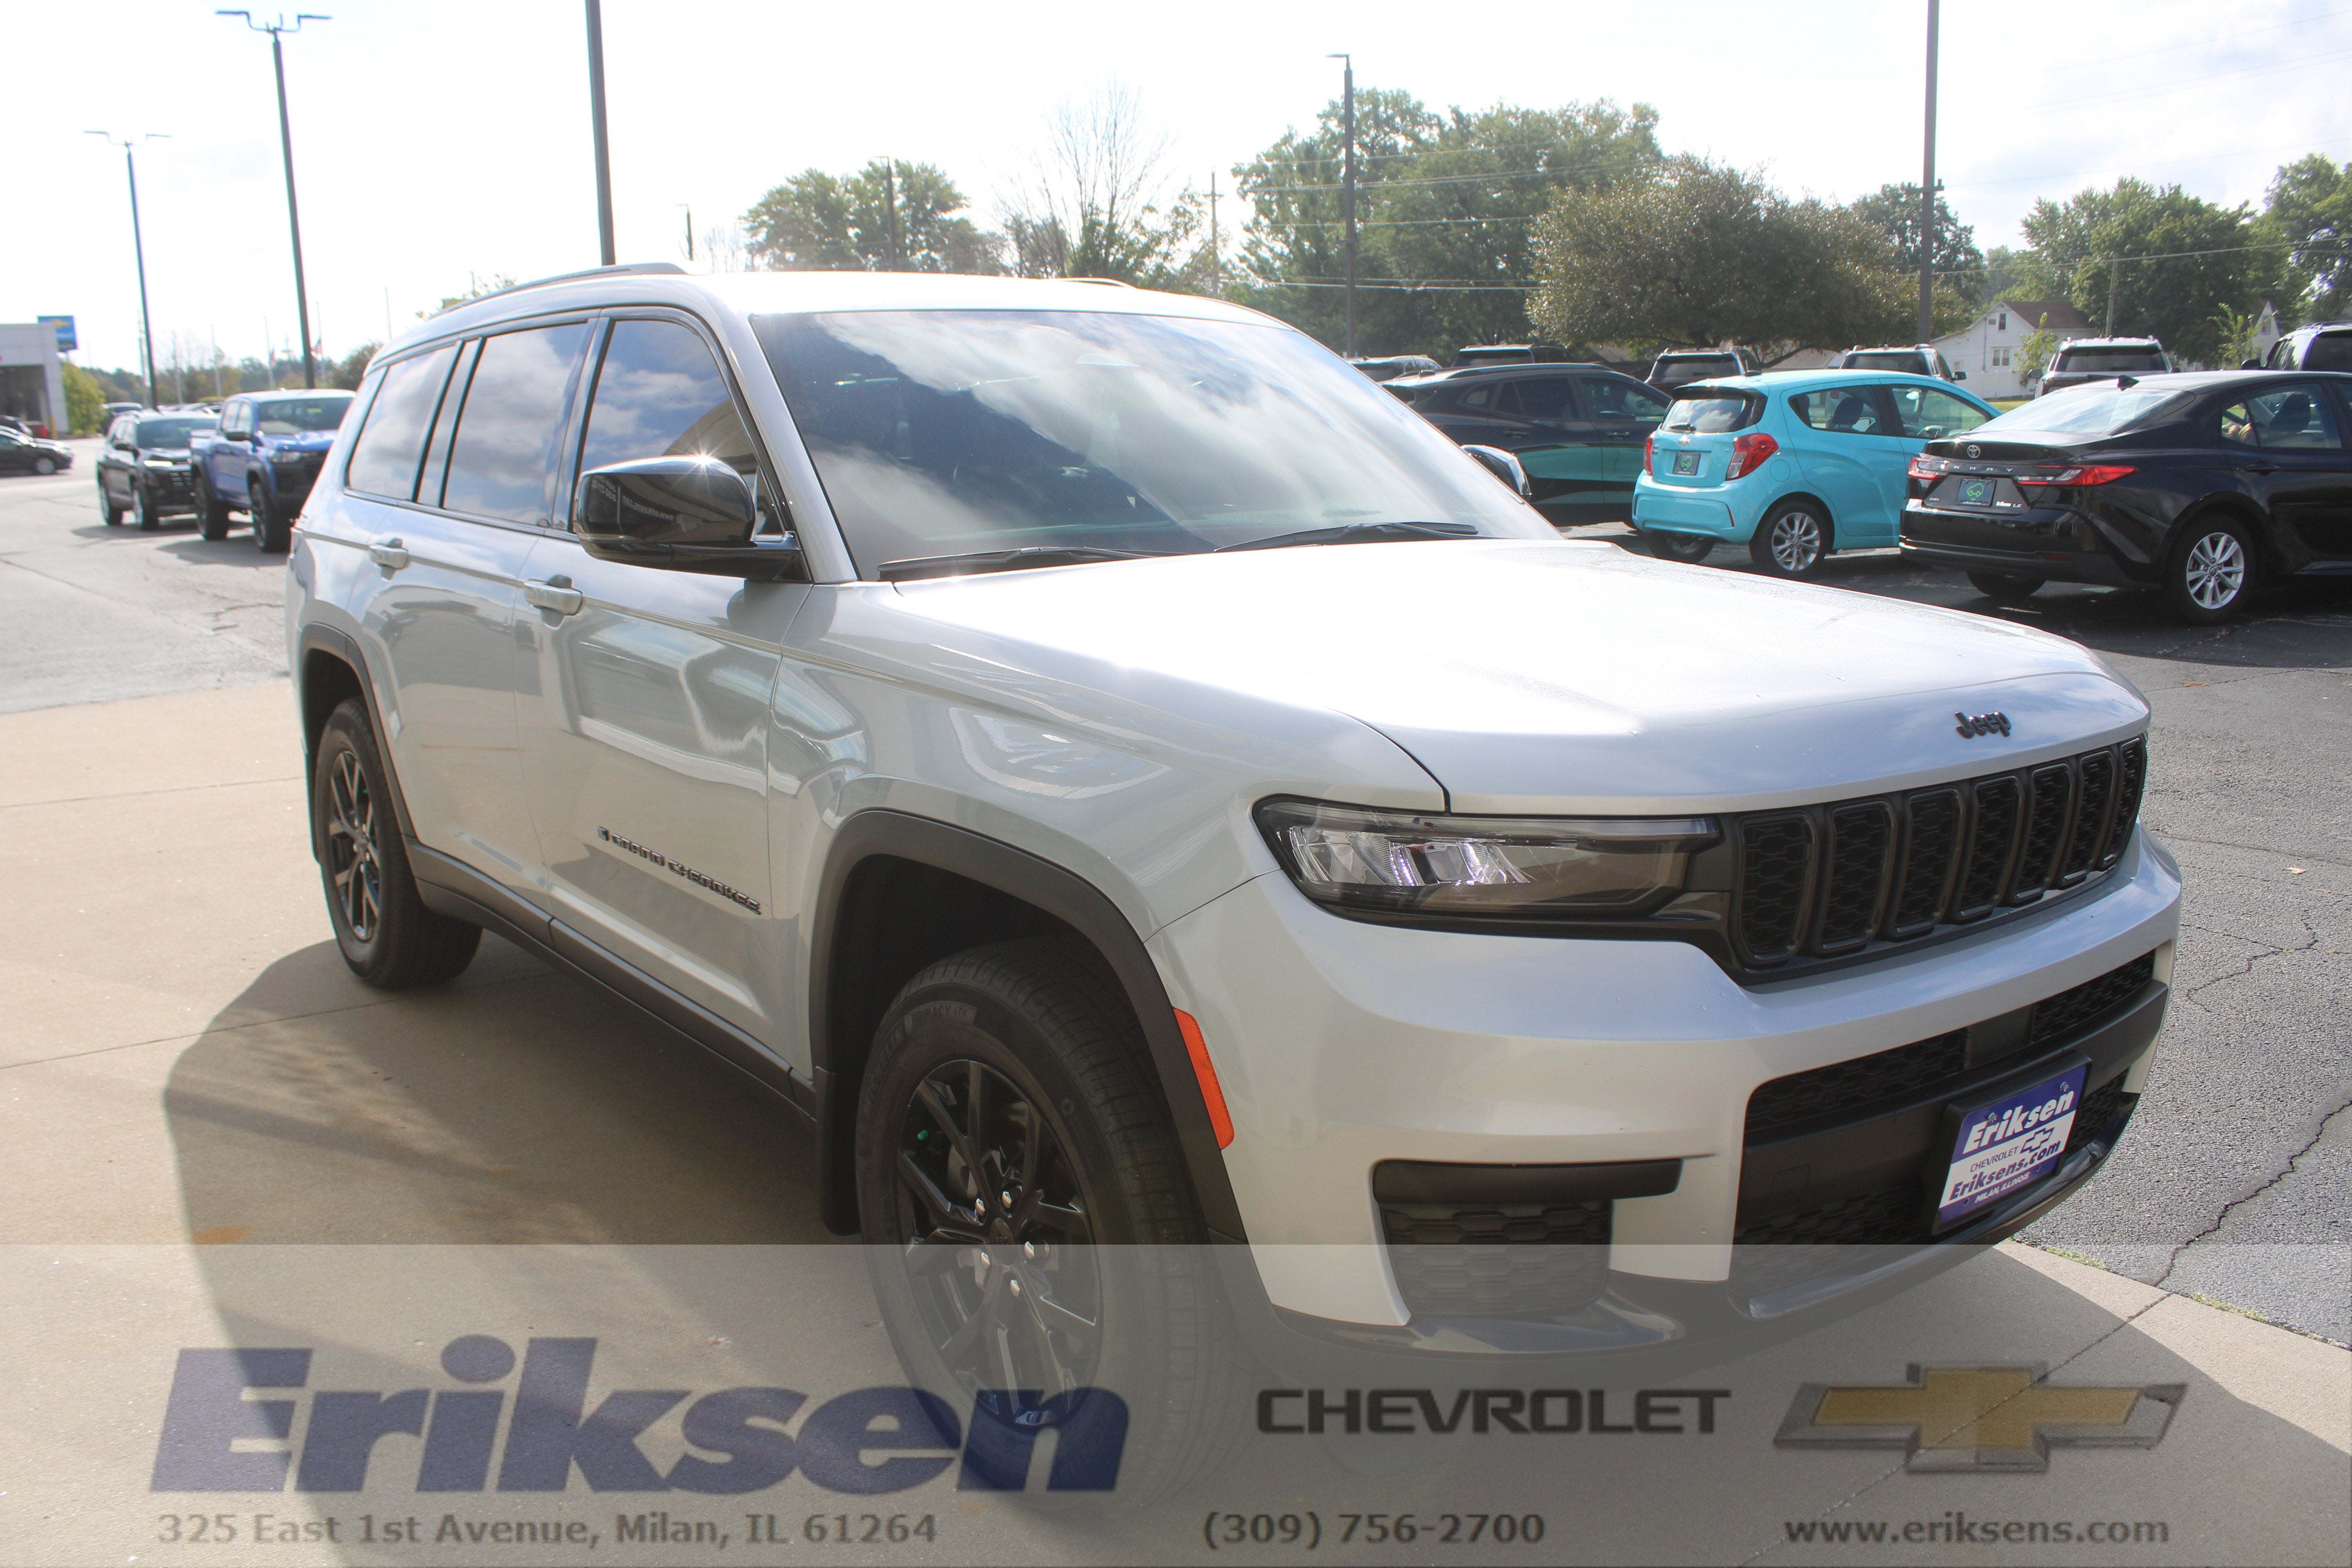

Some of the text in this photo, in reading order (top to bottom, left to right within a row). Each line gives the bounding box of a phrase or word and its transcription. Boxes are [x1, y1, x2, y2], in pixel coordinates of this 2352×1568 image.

[1955, 712, 2011, 739] Jeep
[612, 833, 762, 915] GRAND CHEROKEE
[912, 1005, 968, 1023] PRIMACY LTX
[1962, 1091, 2075, 1154] Eriksen
[1949, 1140, 2061, 1201] Eriksens.com
[1970, 1145, 2020, 1172] CHEVROLET
[1975, 1171, 2031, 1203] MILAN, ILLINOIS
